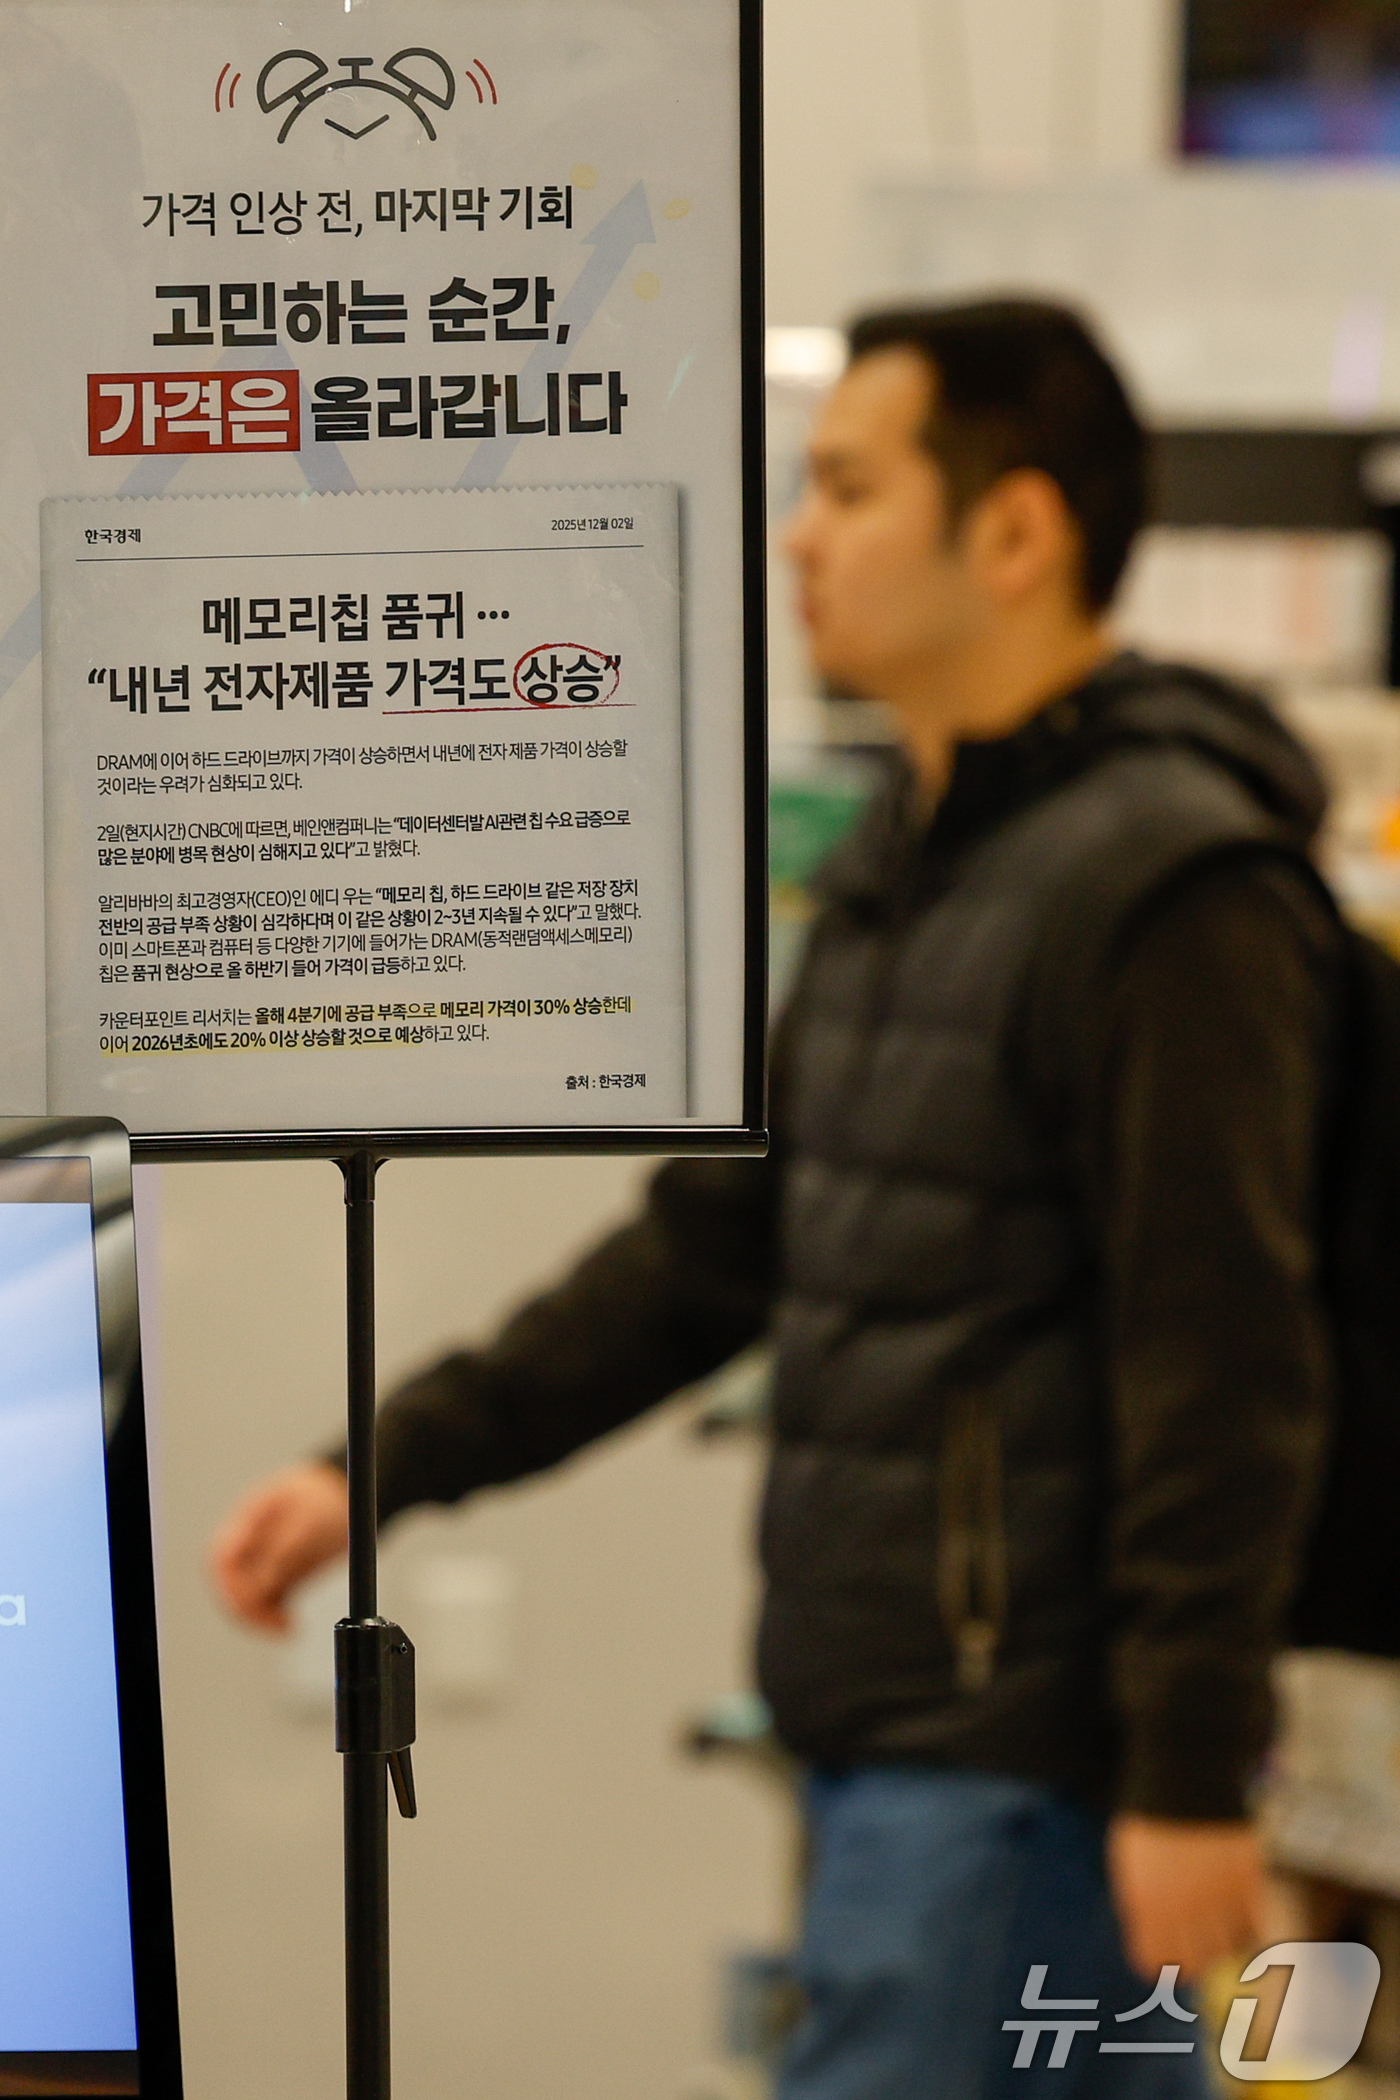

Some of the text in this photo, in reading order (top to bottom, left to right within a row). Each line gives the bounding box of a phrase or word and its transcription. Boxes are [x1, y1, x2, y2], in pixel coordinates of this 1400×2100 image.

[142, 186, 574, 238] 가격 인상 전, 마지막 기회
[152, 277, 572, 347] 고민하는 순간,
[98, 372, 628, 446] 가격은 올라갑니다
[84, 528, 141, 544] 한국경제
[551, 517, 634, 531] 2025년 12월 02일
[203, 593, 368, 645] 메모리칩
[382, 591, 464, 640] 품귀
[88, 655, 621, 714] “내년 전자제품 가격도 상승”
[97, 739, 628, 770] DRAM에 이어 하드 드라이브까지 가격이 상승하면서 내년에 전자 제품 가격이 상승할
[98, 772, 302, 795] 것이라는 우려가 심화되고 있다.
[97, 823, 186, 842] 2일(현지시간)
[188, 821, 242, 839] CNBC에
[246, 820, 291, 839] 따르면,
[293, 817, 392, 837] 베인앤컴퍼니는
[529, 812, 543, 830] 칩
[545, 812, 573, 829] 수요
[575, 810, 631, 828] 급증으로
[98, 839, 420, 866] 많은 분야에 병목 현상이 심해지고 있다”고 밝혔다.
[98, 879, 638, 913] 알리바바의 최고경영자(CEO)인 에디 우는 “메모리 칩, 하드 드라이브 같은 저장 장치
[99, 902, 641, 936] 전반의 공급 부족 상황이 심각하다며 이 같은 상황이 2~3년 지속될 수 있다”고 말했다.
[99, 926, 632, 959] 이미 스마트폰과 컴퓨터 등 다양한 기기에 들어가는 DRAM(동적랜덤액세스메모리)
[99, 954, 466, 983] 칩은 품귀 현상으로 올 하반기 들어 가격이 급등하고 있다.
[100, 996, 631, 1030] 카운터포인트 리서치는 올해 4분기에 공급 부족으로 메모리 가격이 30% 상승한데
[100, 1024, 489, 1053] 이어 2026년초에도 20% 이상 상승할 것으로 예상하고 있다.
[565, 1075, 588, 1090] 출처
[599, 1073, 646, 1088] 한국경제
